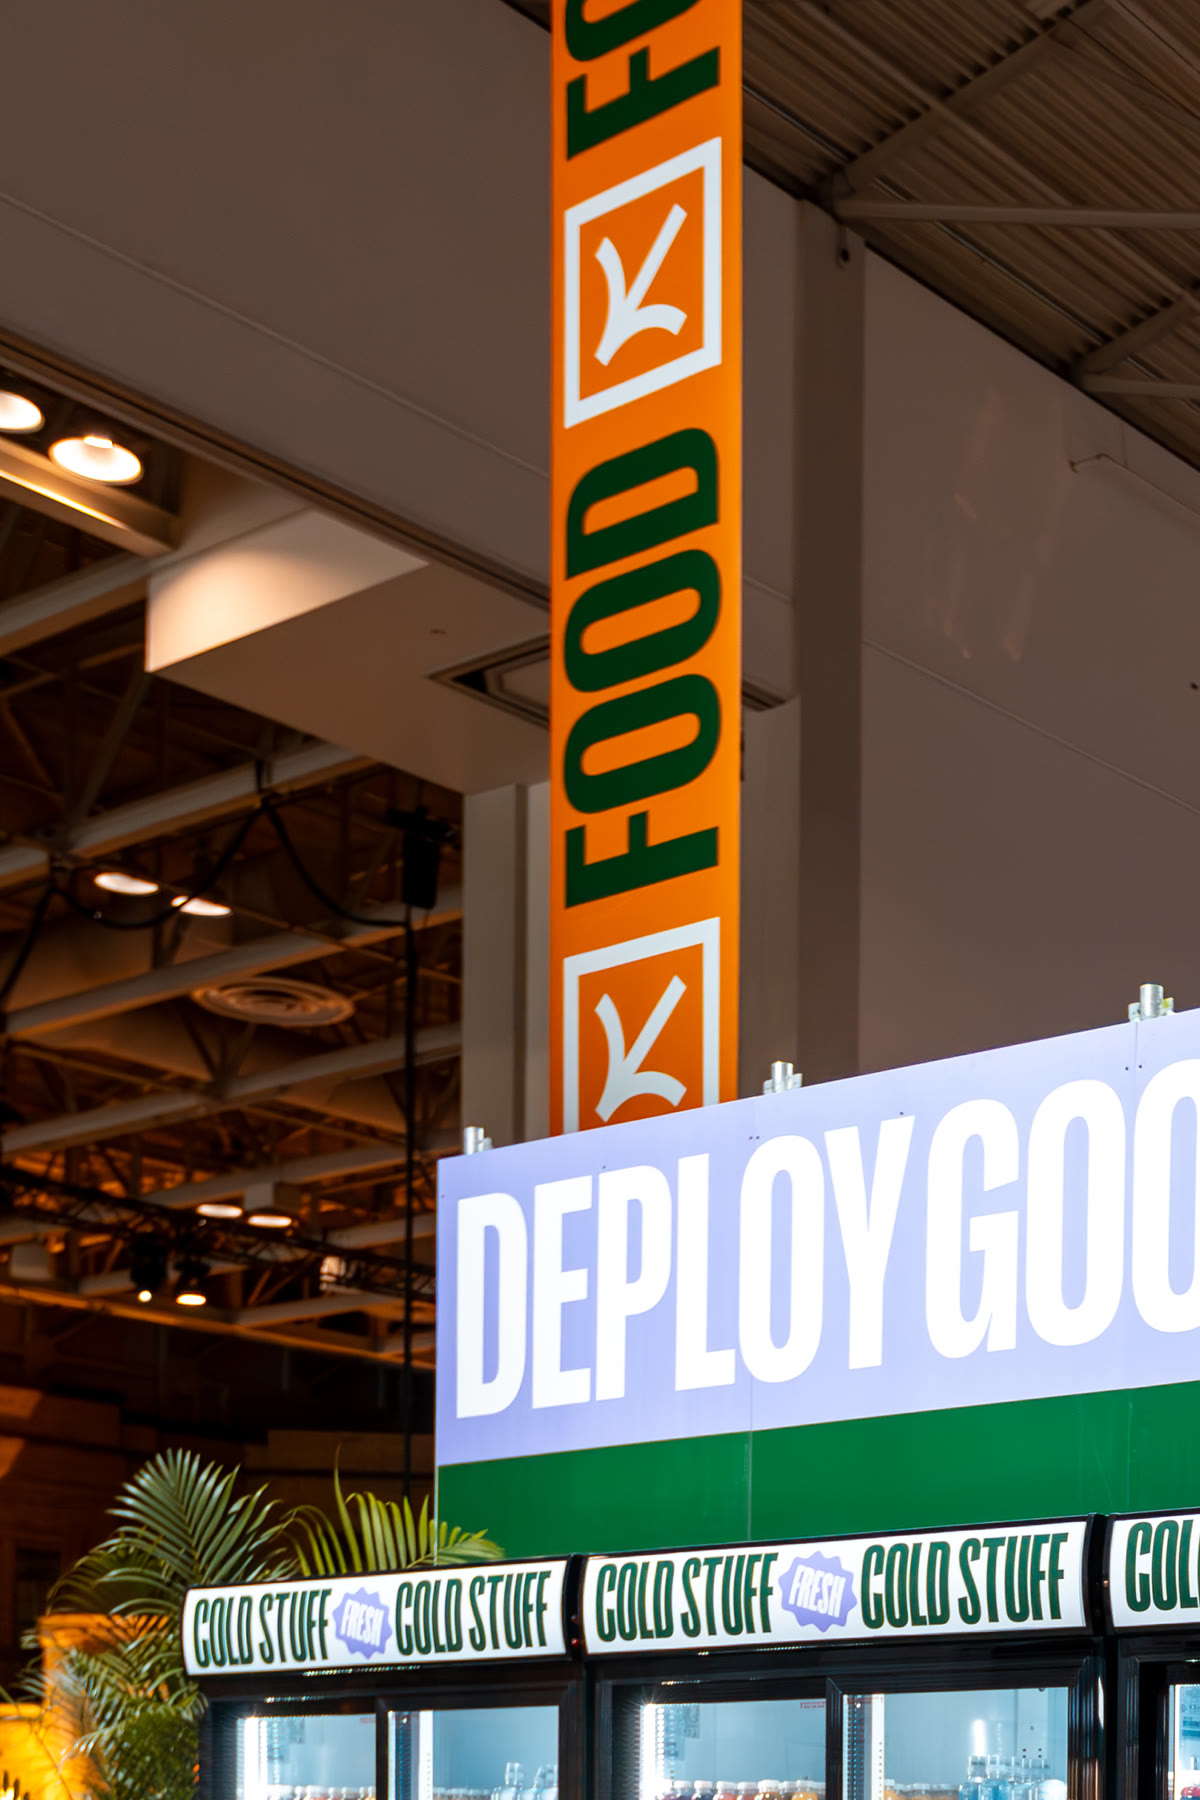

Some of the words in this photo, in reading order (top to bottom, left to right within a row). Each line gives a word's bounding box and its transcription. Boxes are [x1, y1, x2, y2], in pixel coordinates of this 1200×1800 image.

[563, 426, 723, 910] FOOD
[455, 1114, 915, 1420] DEPLOY
[340, 1602, 386, 1648] FRESH
[395, 1578, 464, 1657] COLD
[467, 1569, 552, 1653] STUFF
[596, 1560, 675, 1643] COLD
[680, 1551, 780, 1639] STUFF
[787, 1569, 846, 1619] FRESH
[860, 1540, 951, 1630] COLD
[957, 1531, 1070, 1625] STUFF
[193, 1594, 258, 1669] COLD
[258, 1587, 333, 1666] STUFF
